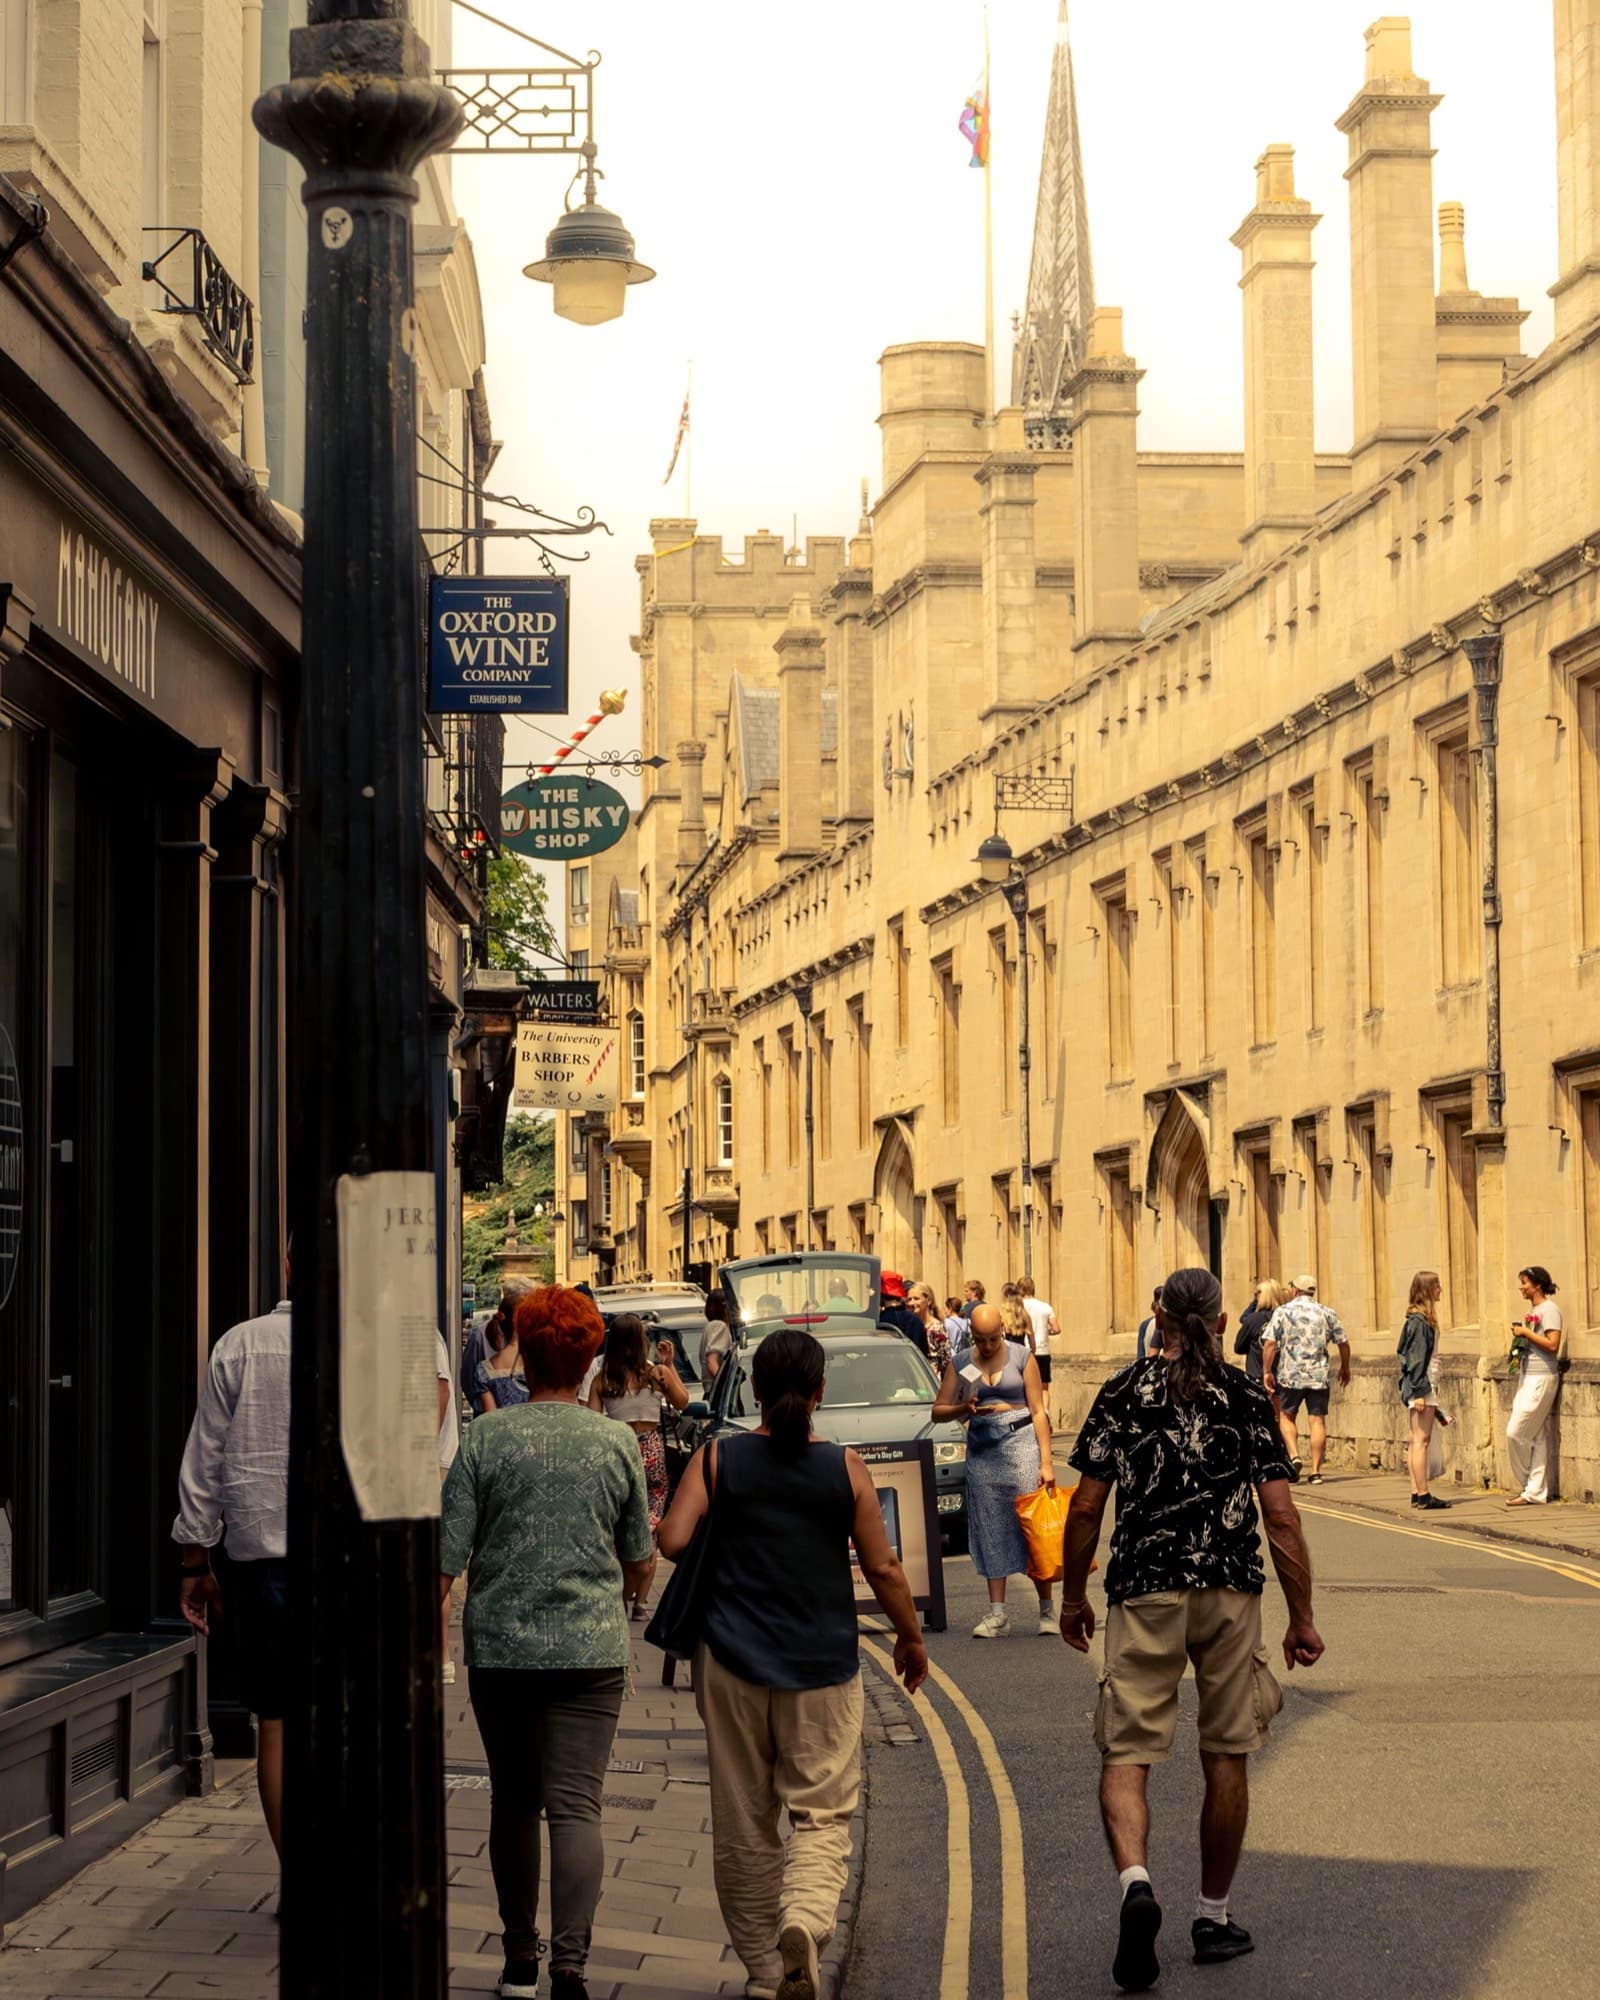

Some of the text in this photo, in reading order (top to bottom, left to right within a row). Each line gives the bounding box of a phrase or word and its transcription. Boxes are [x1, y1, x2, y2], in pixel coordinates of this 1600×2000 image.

[57, 520, 159, 700] MAHOGANY
[484, 597, 512, 608] THE
[439, 611, 557, 634] OXFORD
[445, 637, 549, 666] WINE
[462, 670, 532, 682] COMPANY
[469, 695, 507, 704] ESTABLISHED
[540, 788, 579, 803] THE
[500, 805, 625, 831] WHISKY
[535, 833, 590, 849] SHOP
[527, 992, 594, 1009] WALTERS
[522, 1030, 603, 1047] The University
[521, 1051, 591, 1065] BARBERS
[534, 1070, 574, 1083] SHOP
